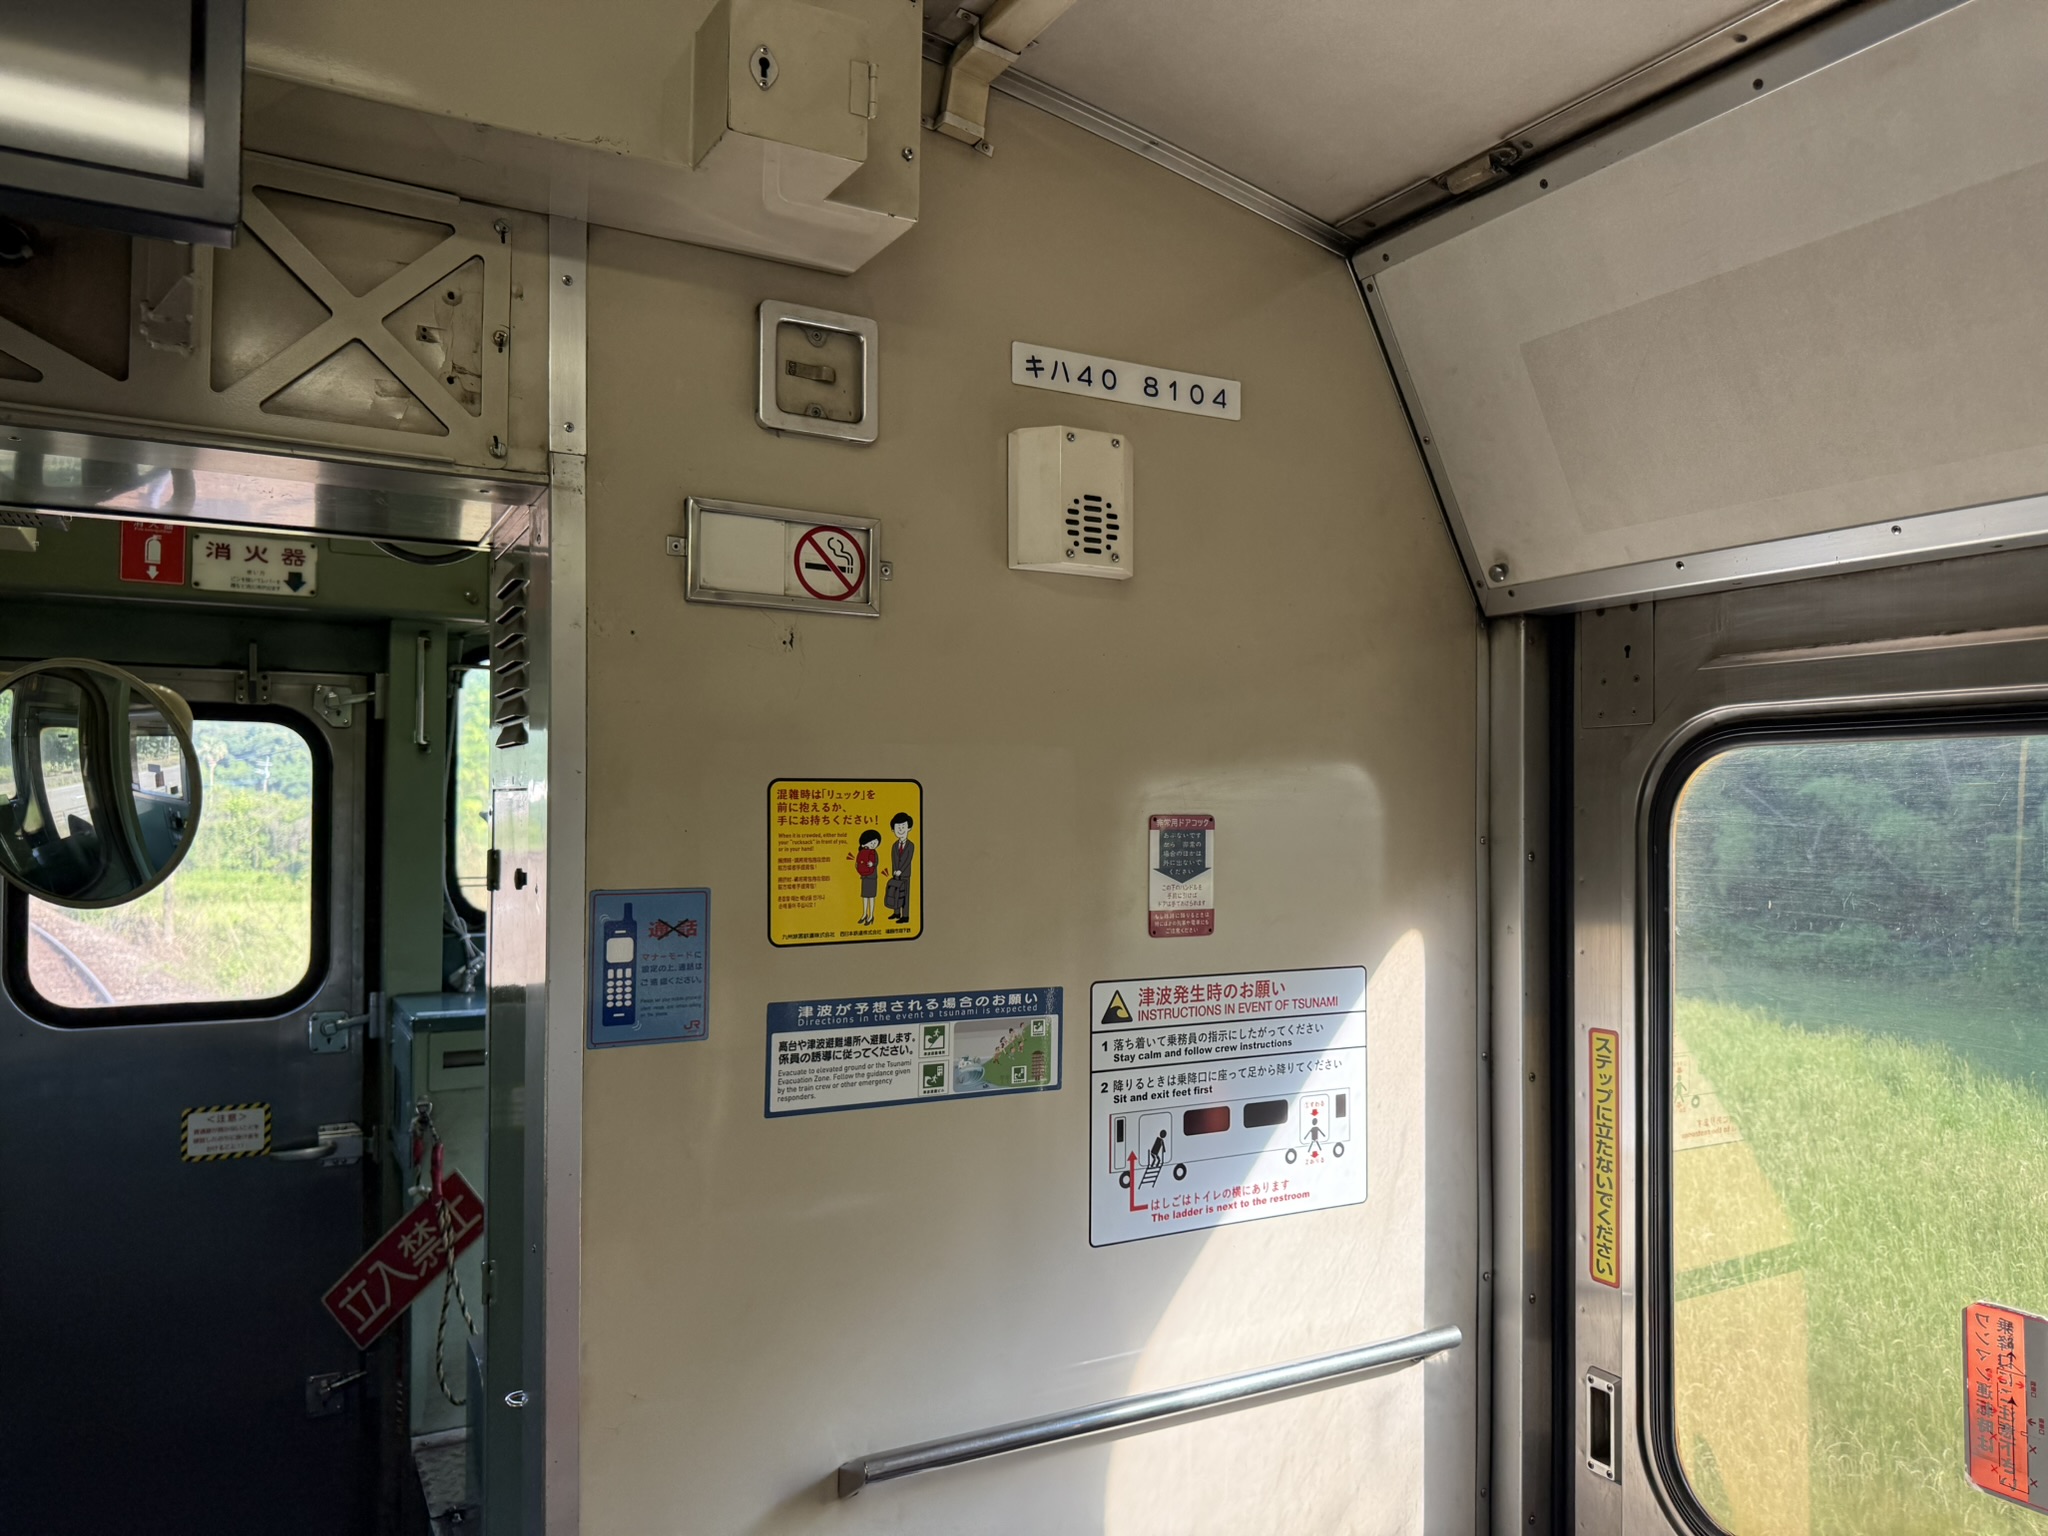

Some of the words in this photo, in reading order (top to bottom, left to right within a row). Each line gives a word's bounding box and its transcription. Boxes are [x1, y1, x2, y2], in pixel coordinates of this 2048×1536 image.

[1025, 355, 1117, 390] キハ40
[1143, 376, 1227, 409] 8104
[206, 541, 307, 567] 消火器
[777, 788, 876, 801] 混雑時は「リュック」を
[777, 802, 847, 813] 前に抱えるか、
[1156, 818, 1209, 828] 非常用ドアコック
[642, 951, 702, 961] マナーモードに
[1138, 979, 1286, 1007] 津波発生時のお願い
[798, 992, 1039, 1018] 津波が予想される場合のお願い
[798, 1016, 855, 1027] Directions
[874, 1012, 891, 1021] the
[896, 1011, 925, 1019] event
[939, 1009, 979, 1017] tsunami
[995, 1003, 1038, 1014] expected
[1137, 1004, 1222, 1022] INSTRUCTIONS
[1224, 1003, 1236, 1014] IN
[1238, 1001, 1273, 1014] EVENT
[1274, 999, 1289, 1012] OF
[1291, 995, 1339, 1010] TSUNAMI
[683, 1020, 700, 1030] JR
[778, 1032, 915, 1052] 高台や津波避難場所へ避難します。
[1101, 1041, 1108, 1052] 1
[1113, 1022, 1324, 1052] 落ち着いて乗務員の指示にしたがってください
[778, 1045, 913, 1065] 係員の誘導に従ってください。
[1113, 1053, 1136, 1064] Stay
[1138, 1050, 1162, 1060] calm
[1164, 1048, 1182, 1058] and
[1184, 1046, 1213, 1056] follow
[1215, 1045, 1237, 1054] crew
[1239, 1039, 1293, 1051] instructions
[777, 1068, 808, 1077] Evacuate
[808, 1067, 815, 1075] to
[816, 1065, 843, 1074] elevated
[844, 1063, 867, 1073] ground
[875, 1061, 886, 1069] the
[886, 1059, 912, 1068] Tsunami
[777, 1076, 813, 1086] Evacuation
[813, 1074, 832, 1082] Zone.
[833, 1072, 854, 1080] Follow
[866, 1069, 894, 1079] guidance
[1100, 1082, 1109, 1094] 2
[1112, 1058, 1343, 1093] 降りるときは乗降口に座って足から降りてください
[786, 1085, 797, 1093] the
[798, 1083, 814, 1092] train
[815, 1082, 831, 1090] crew
[840, 1080, 857, 1088] other
[858, 1078, 893, 1087] emergency
[1113, 1093, 1128, 1104] Sit
[1130, 1092, 1148, 1102] and
[1150, 1089, 1170, 1100] exit
[1172, 1087, 1191, 1098] feet
[1193, 1085, 1213, 1096] first
[776, 1093, 816, 1102] responders.
[1595, 1036, 1614, 1277] ステップに立たないでください
[1151, 1179, 1290, 1211] はしごはトイレの横にあります
[1151, 1213, 1170, 1223] The
[1173, 1208, 1203, 1219] ladder
[1205, 1205, 1214, 1214] is
[1216, 1202, 1238, 1212] next
[1240, 1199, 1250, 1208] to
[1252, 1196, 1267, 1206] the
[1269, 1190, 1311, 1204] restroom
